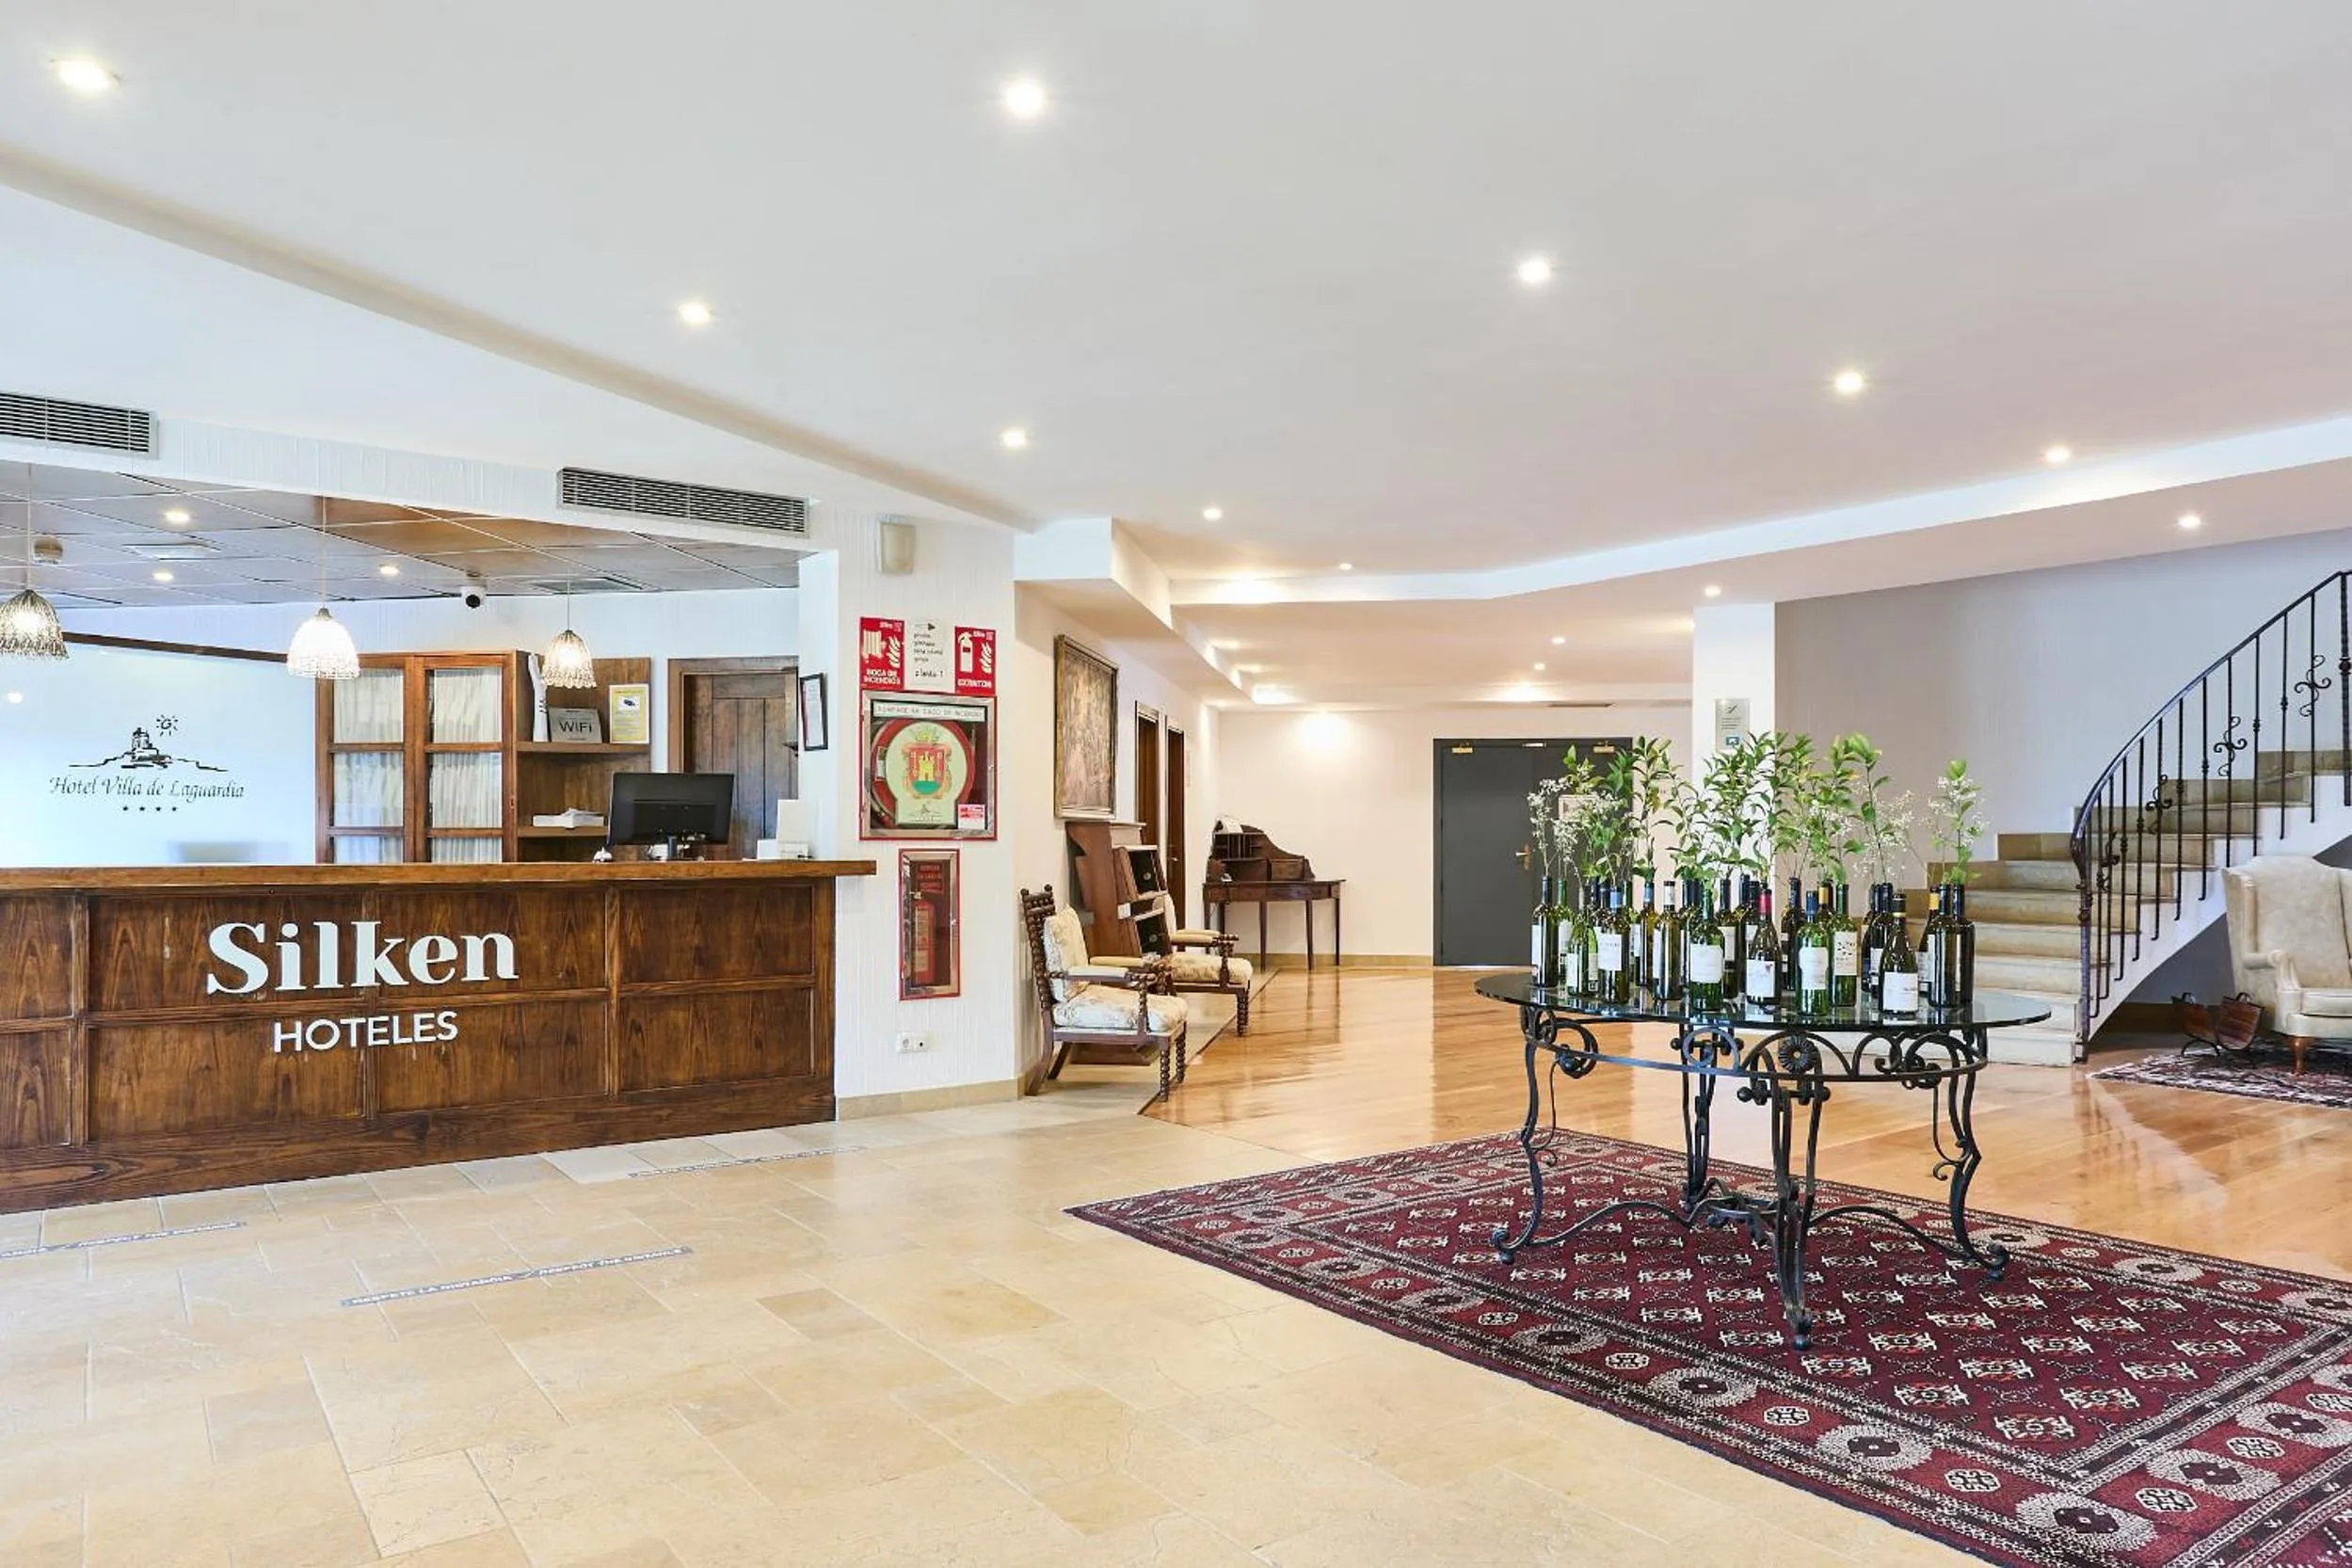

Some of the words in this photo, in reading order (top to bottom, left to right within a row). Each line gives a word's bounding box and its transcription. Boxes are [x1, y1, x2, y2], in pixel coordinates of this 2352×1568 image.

[49, 776, 96, 795] Hotel
[101, 775, 142, 796] Villa
[146, 777, 164, 796] de
[169, 779, 245, 803] Laguardia
[206, 920, 520, 995] Silken
[273, 1010, 459, 1053] HOTELES
